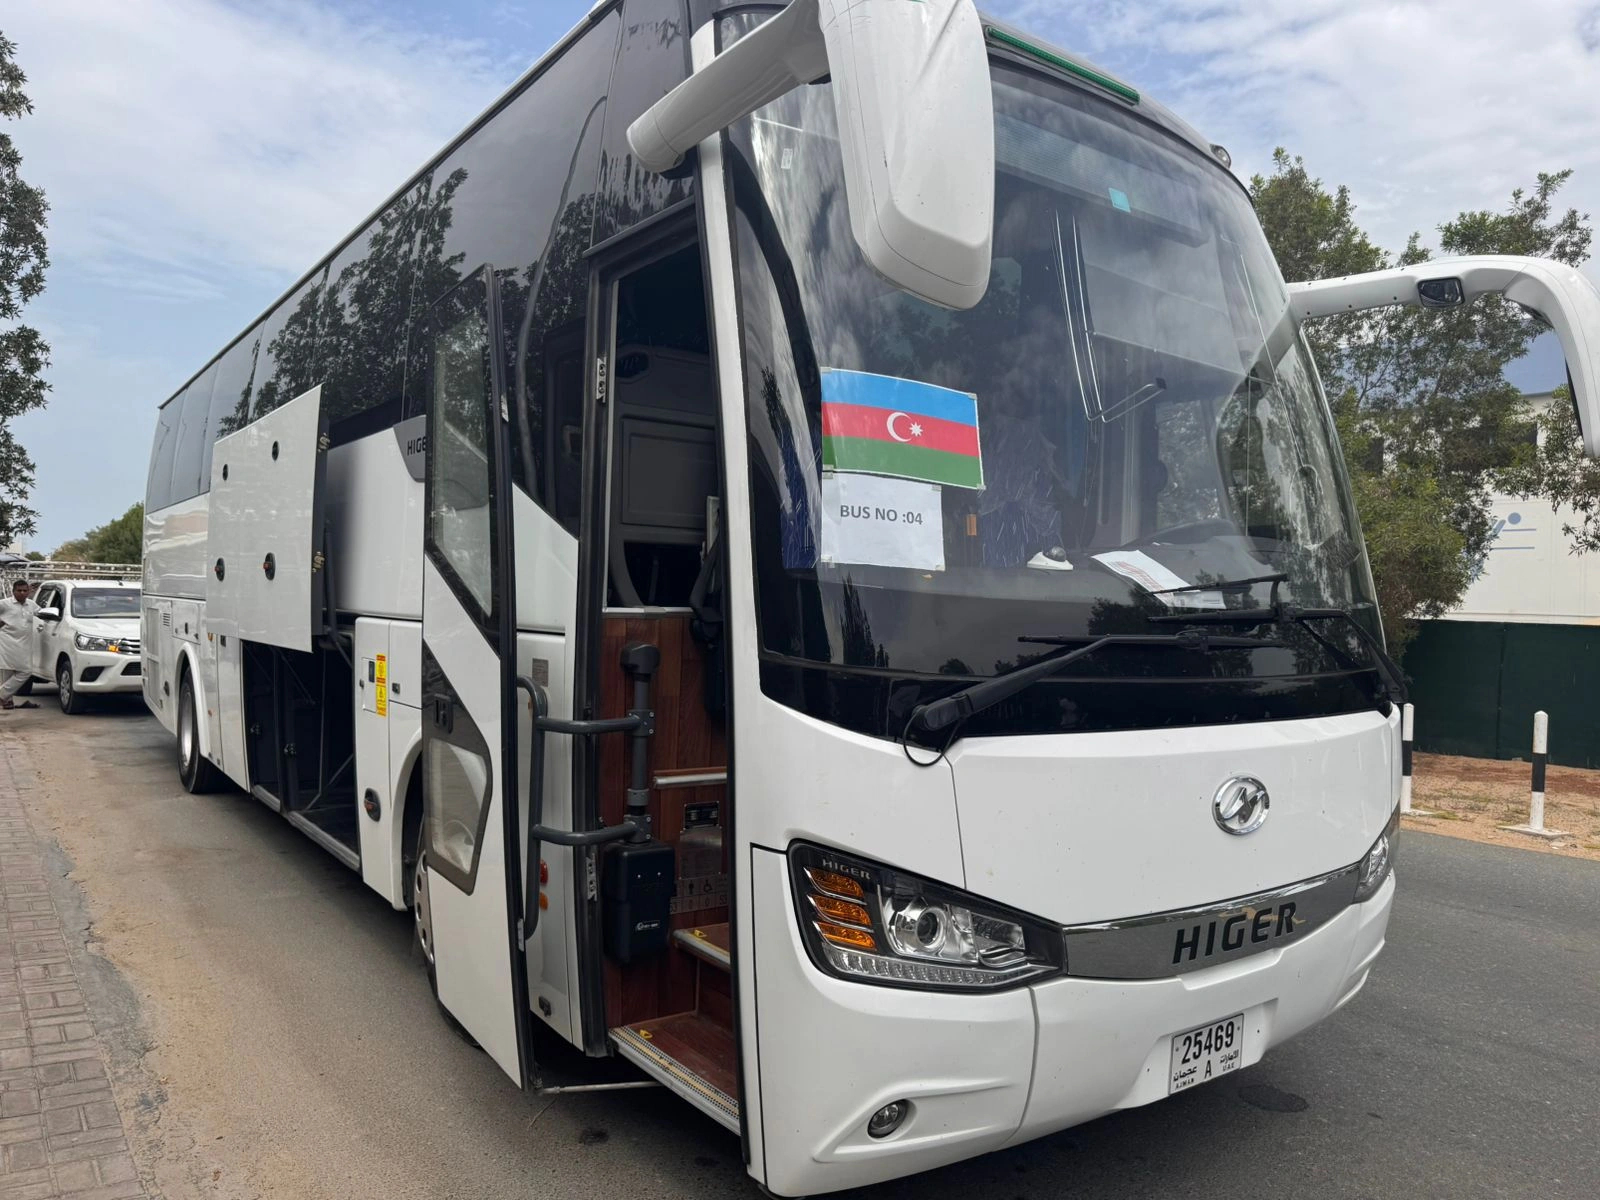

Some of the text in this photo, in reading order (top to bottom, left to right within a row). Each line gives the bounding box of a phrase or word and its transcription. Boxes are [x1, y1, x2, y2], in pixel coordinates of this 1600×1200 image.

[407, 436, 426, 456] HIGE
[840, 504, 923, 526] BUS NO :04
[822, 859, 871, 880] HIGER
[1172, 902, 1297, 964] HIGER
[1181, 1020, 1235, 1065] 25469
[1173, 1066, 1198, 1082] عجمان
[1204, 1059, 1212, 1079] A
